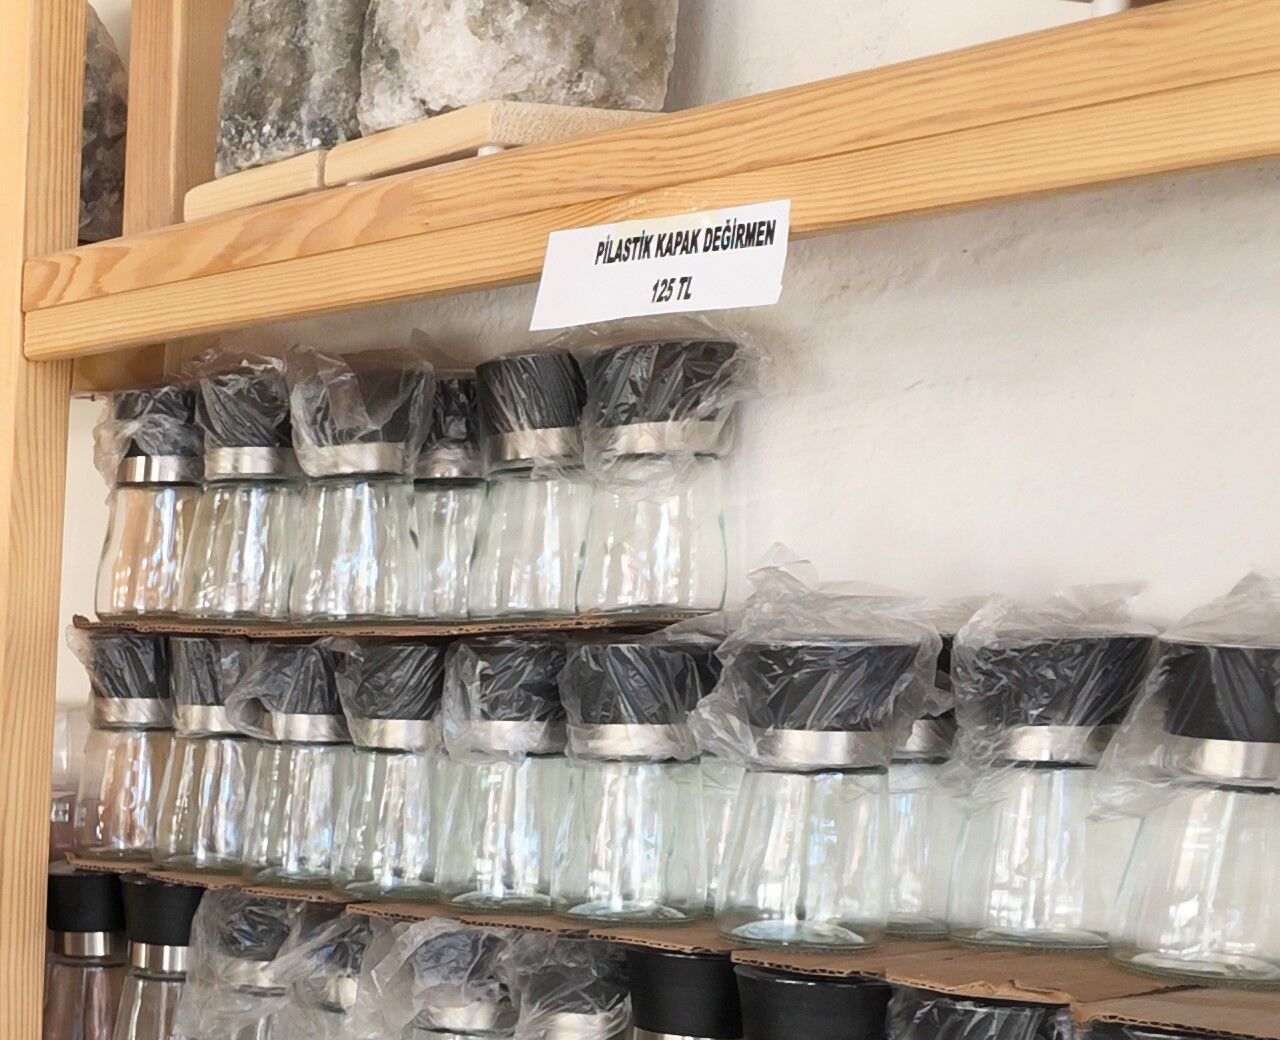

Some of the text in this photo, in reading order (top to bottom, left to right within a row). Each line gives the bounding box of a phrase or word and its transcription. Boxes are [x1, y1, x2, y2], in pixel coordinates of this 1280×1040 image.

[594, 217, 777, 266] PİLASTİK KAPAK DEĞİRMEN
[650, 276, 693, 303] 125 TL
